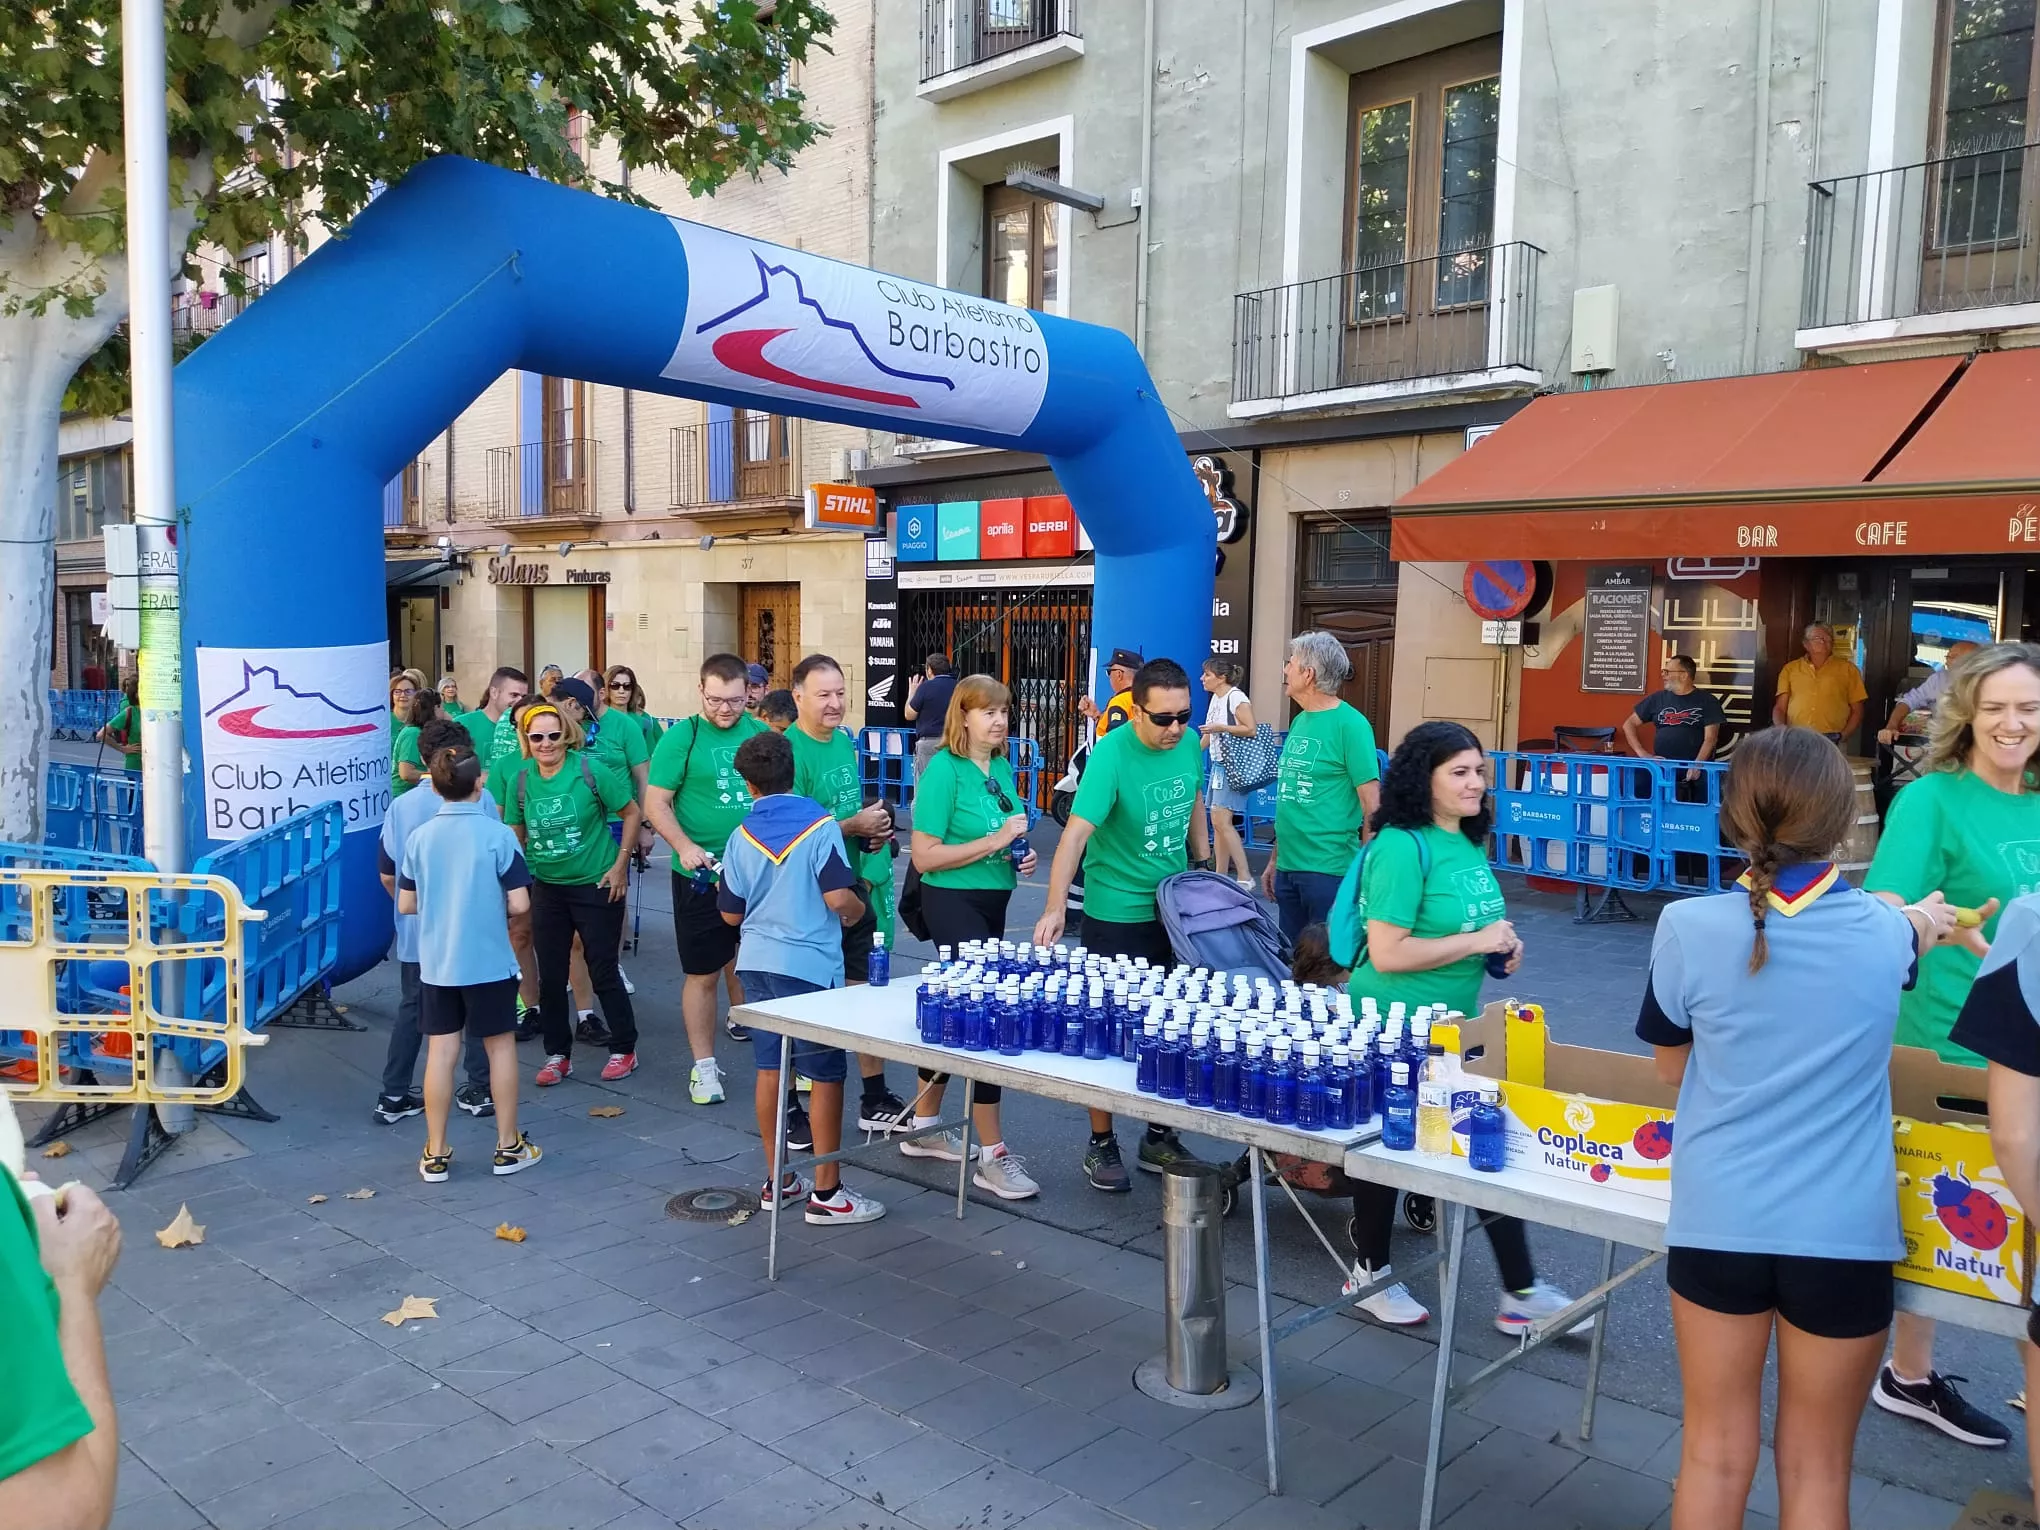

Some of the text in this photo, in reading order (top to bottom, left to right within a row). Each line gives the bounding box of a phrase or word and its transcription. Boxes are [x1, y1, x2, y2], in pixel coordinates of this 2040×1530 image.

[877, 279, 1033, 333] Club Atletismo
[888, 310, 1041, 373] Barbastro
[824, 494, 871, 514] STIHL
[986, 522, 1014, 537] aprilia
[1029, 520, 1068, 533] DERBI
[1737, 516, 2040, 548] BAR CAFE PE
[487, 555, 611, 584] Solans Pinturas
[741, 557, 754, 570] 37
[868, 601, 897, 610] Kawasaki
[1592, 594, 1642, 604] RACIONES
[872, 618, 892, 629] KTM
[869, 637, 894, 648] YAMAHA
[874, 657, 896, 666] SUZUKI
[868, 700, 896, 708] HONDA
[212, 756, 389, 790] Club Atletismo
[213, 788, 390, 830] Barbstro
[1522, 811, 1561, 821] BARBASTRO
[1537, 1127, 1624, 1161] Coplaca
[1544, 1151, 1588, 1173] Natur
[1935, 1248, 2006, 1279] Natur
